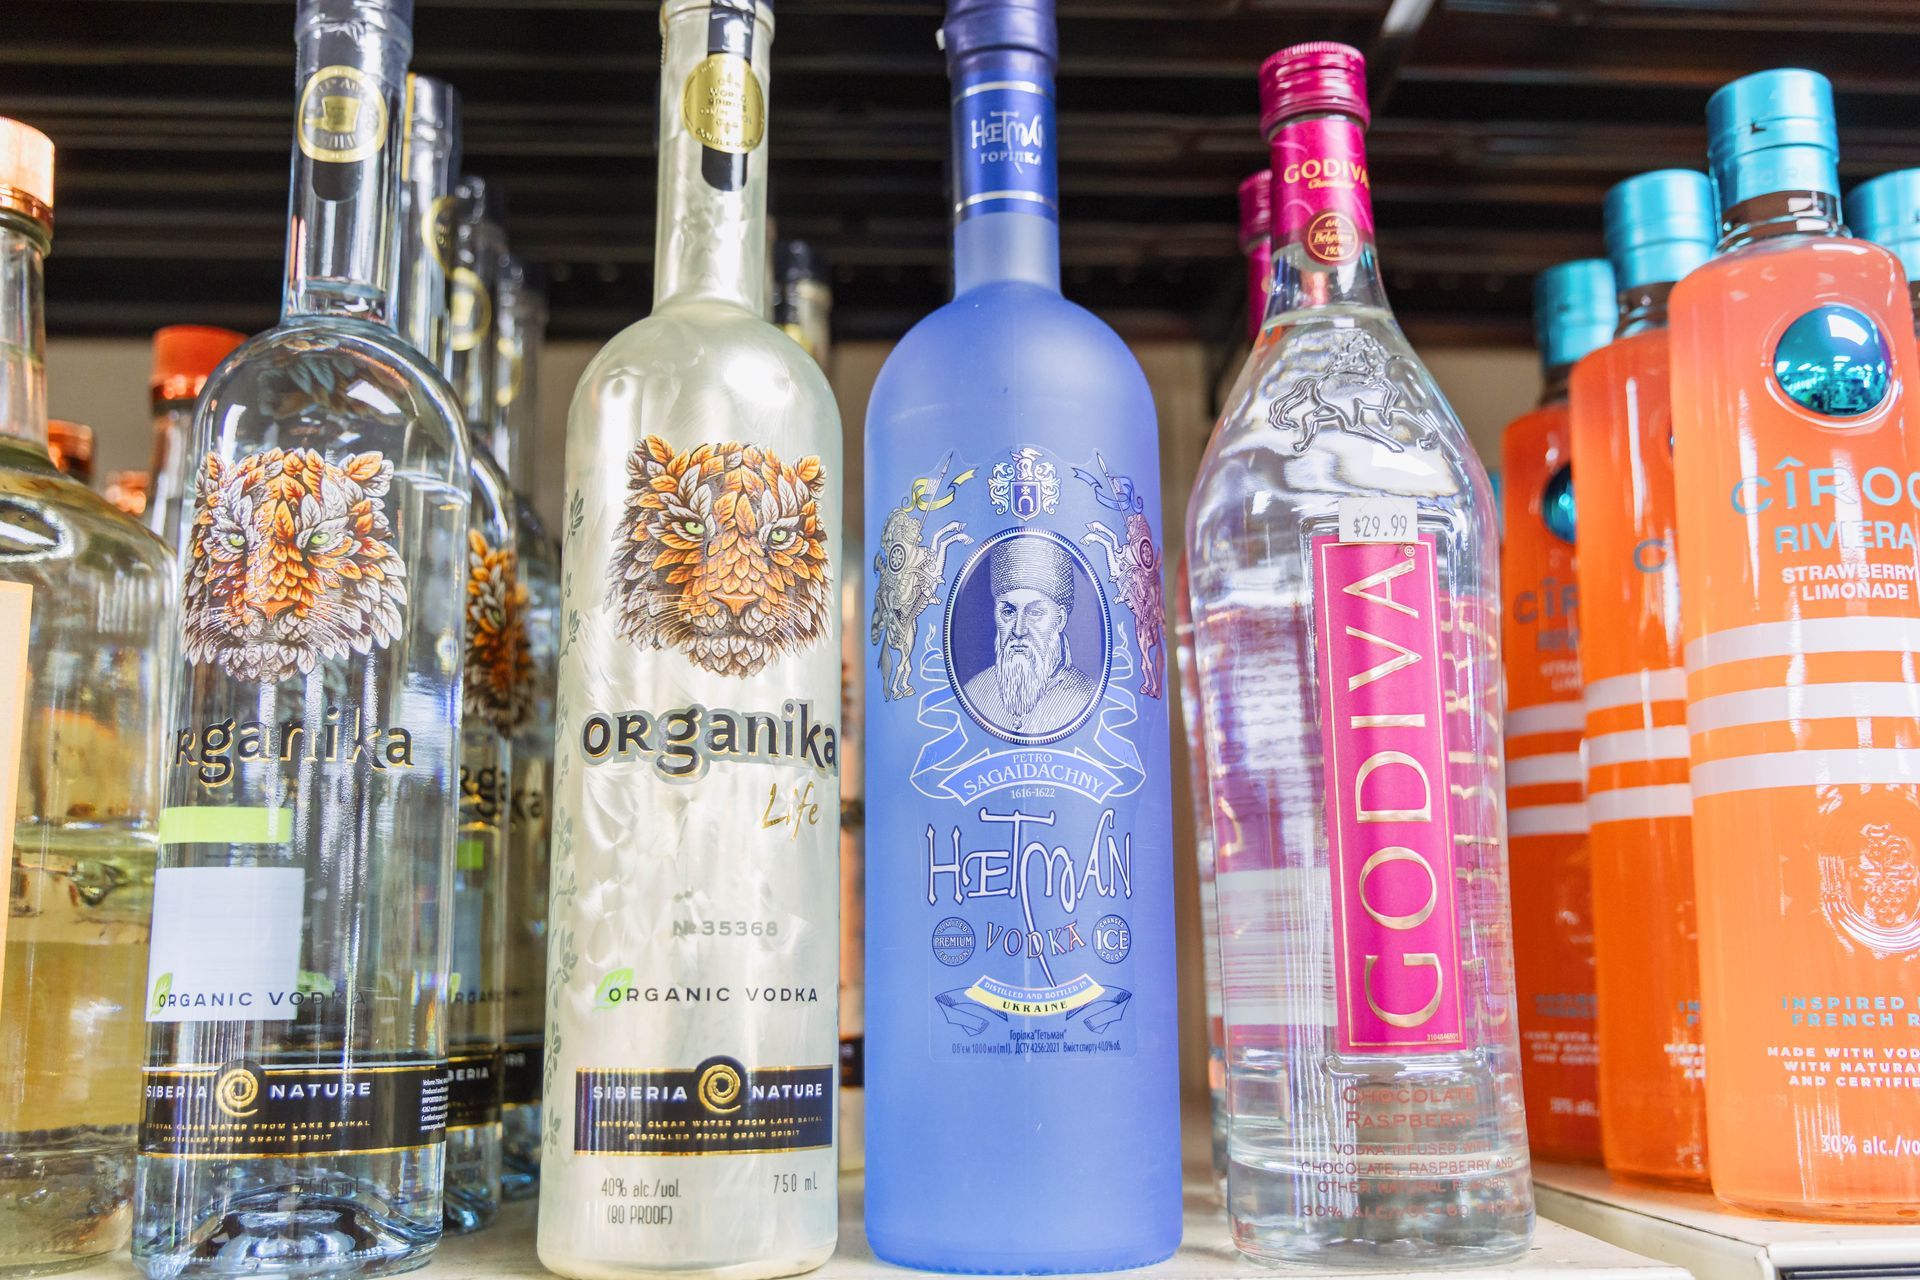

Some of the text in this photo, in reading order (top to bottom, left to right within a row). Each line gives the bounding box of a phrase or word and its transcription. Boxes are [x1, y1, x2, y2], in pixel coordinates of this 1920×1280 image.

[1353, 515, 1408, 538] $29.99
[1774, 521, 1917, 553] RIVIERA
[1782, 563, 1916, 584] STRAWBERRY
[1802, 582, 1909, 600] LIMONADE
[1013, 753, 1053, 764] PETRO
[963, 763, 1104, 796] SAGAIDACHNY
[1011, 787, 1055, 799] 1616-1622
[761, 782, 819, 840] Life
[1099, 917, 1124, 928] CHANGES
[933, 935, 973, 947] PREMIUM
[985, 919, 1086, 959] VODKA
[1096, 929, 1129, 950] ICE
[1101, 950, 1124, 961] COLOR
[608, 987, 819, 1002] ORGANIC VODKA
[984, 981, 1024, 999] DISTILLED
[1025, 992, 1043, 1000] AND
[1045, 986, 1079, 999] BOTTLED
[158, 991, 366, 1007] ORGANIC VODKA
[1782, 996, 1905, 1010] INSPIRED
[1002, 1000, 1068, 1013] UKRAINE
[1791, 1013, 1895, 1027] FRENCH
[1767, 1047, 1920, 1058] MADE WITH VOD
[1784, 1062, 1920, 1073] WITH NATURA
[1789, 1076, 1920, 1088] AND CERTIFIE
[146, 1082, 372, 1099] SIBERIA NATURE
[593, 1083, 823, 1100] SIBERIA NATURE
[210, 1123, 248, 1131] WATER
[253, 1122, 286, 1130] FROM
[292, 1121, 323, 1129] LAKE
[329, 1120, 371, 1129] BAIKAL
[647, 1120, 686, 1128] CLEAR
[692, 1119, 732, 1127] WATER
[737, 1118, 766, 1126] FROM
[770, 1117, 794, 1125] LAKE
[212, 1136, 243, 1144] FROM
[292, 1134, 333, 1142] SPIRIT
[628, 1129, 800, 1141] DISTILLED FROM GRAIN SPIRIT
[1333, 1143, 1385, 1155] VODKA
[1391, 1143, 1457, 1156] INFUSED
[1821, 1135, 1920, 1157] 30% alc./vo
[1409, 1160, 1491, 1174] RASPBERRY
[1496, 1157, 1514, 1169] AND
[601, 1178, 628, 1197] 40%
[773, 1173, 797, 1194] 750
[1317, 1180, 1372, 1194] OTHER
[607, 1205, 673, 1225] (80 PROOF)
[1303, 1204, 1343, 1218] 30%
